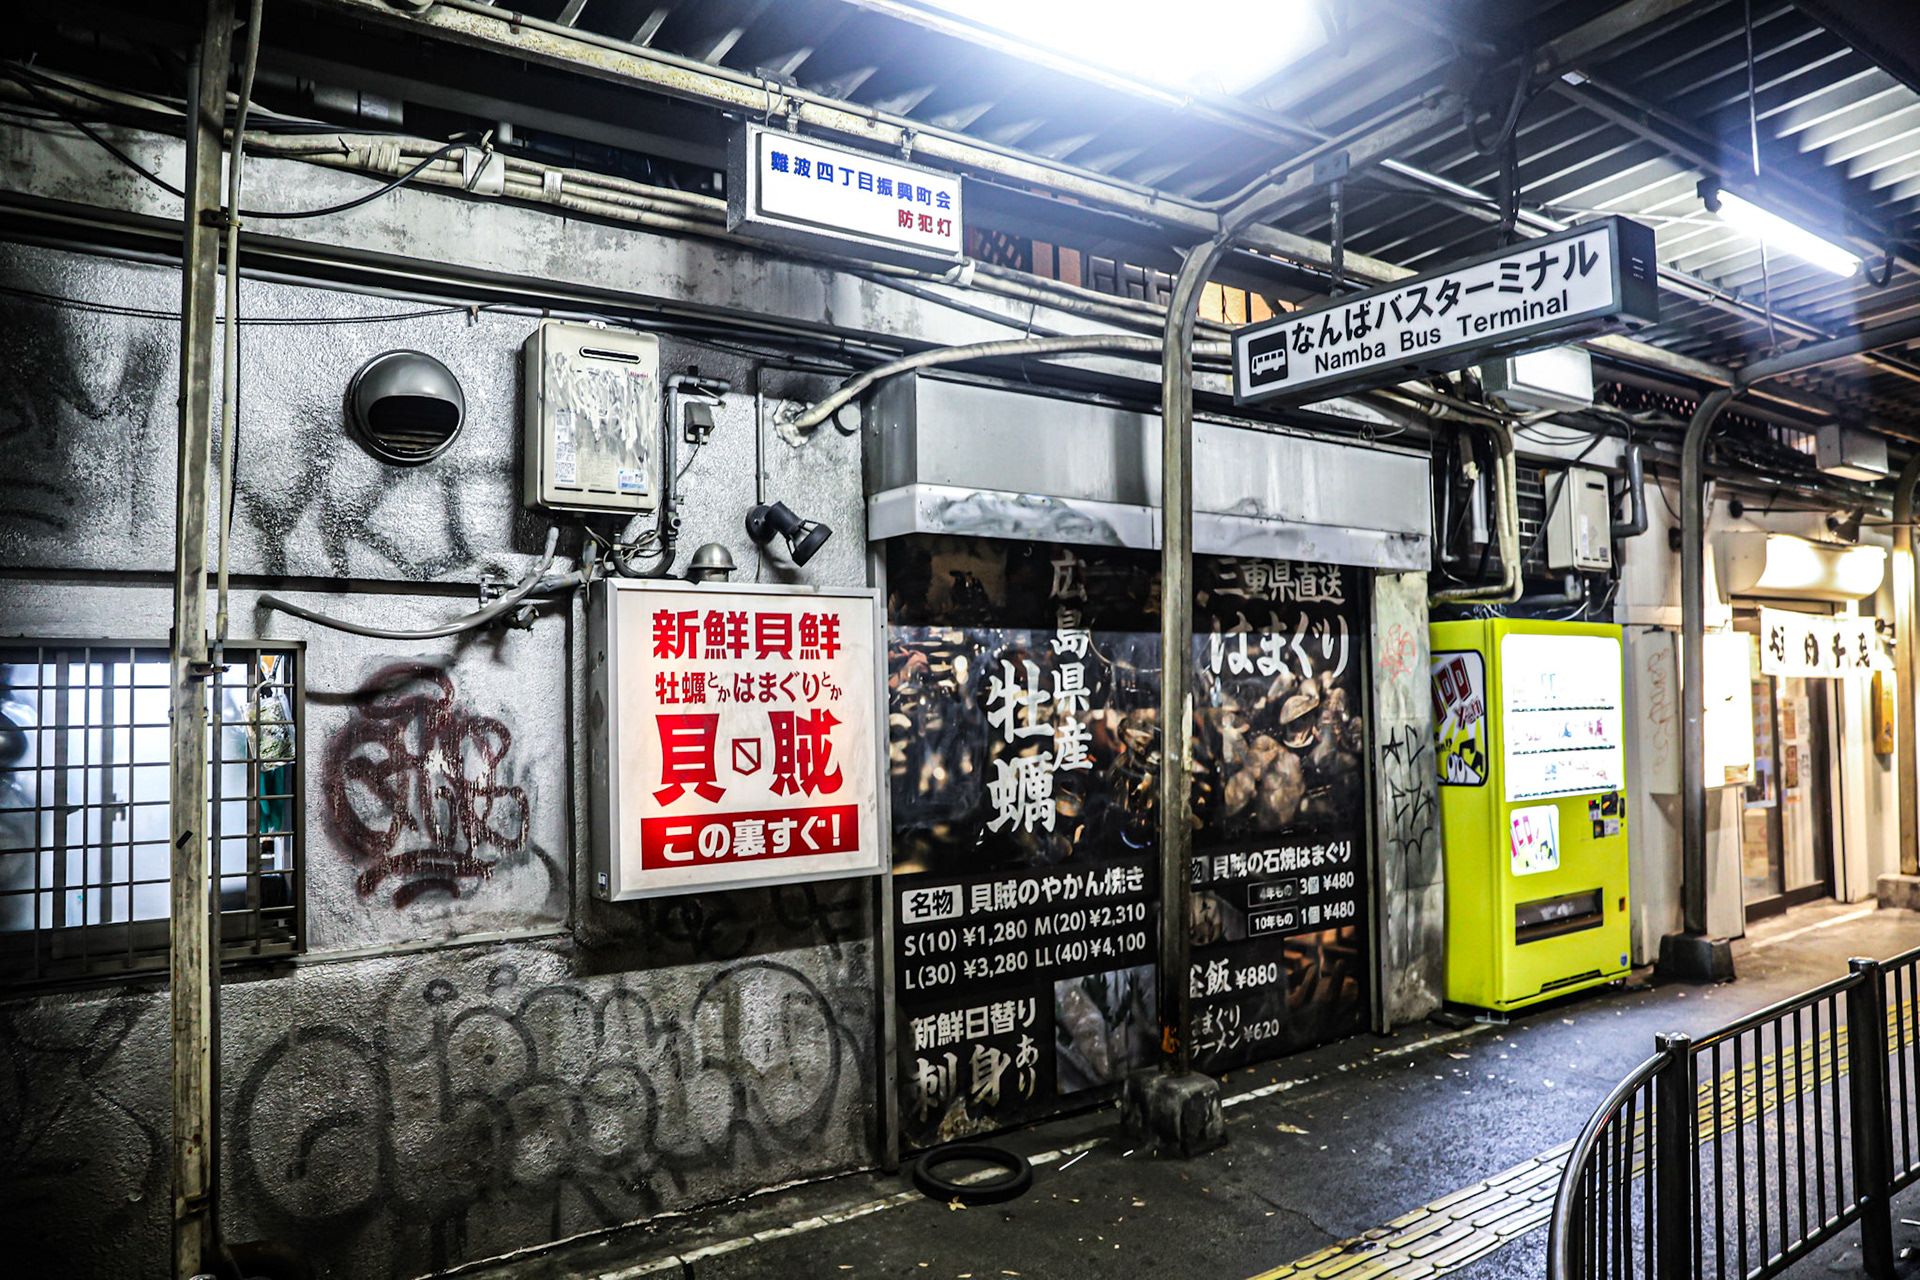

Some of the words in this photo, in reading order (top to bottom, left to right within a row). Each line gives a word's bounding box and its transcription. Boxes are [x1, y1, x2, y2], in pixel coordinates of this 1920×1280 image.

[771, 150, 951, 210] 難波四丁目振興町会
[898, 209, 952, 237] 防犯灯
[1291, 240, 1598, 355] なんばバスターミナル
[1315, 340, 1386, 374] Namba
[1400, 325, 1441, 352] Bus
[1457, 289, 1569, 338] Terminal
[1213, 557, 1346, 605] 三重県直送
[653, 609, 841, 660] 新鮮貝鮮
[1210, 611, 1349, 679] はまぐり
[1050, 549, 1093, 772] 広島県産
[986, 659, 1056, 834] 牡蠣
[663, 813, 841, 862] この裏すぐ!
[1213, 840, 1351, 882] 貝賊の石焼はまぐり
[910, 889, 954, 918] 名物
[970, 866, 1145, 914] 貝賊のやかん焼き
[1300, 875, 1320, 895] 3個
[1323, 871, 1354, 891] ¥480
[963, 919, 1028, 947] ¥1,280
[1089, 902, 1146, 927] ¥2,310
[1255, 913, 1293, 930] 10年もの
[1301, 906, 1320, 925] 1個
[1323, 900, 1355, 921] ¥480
[963, 951, 1029, 979] ¥3,280
[1090, 931, 1146, 957] ¥4,100
[1235, 962, 1277, 990] ¥880
[911, 997, 1037, 1052] 新鮮日替り
[1243, 1019, 1279, 1043] ¥620
[1016, 1033, 1039, 1099] あり
